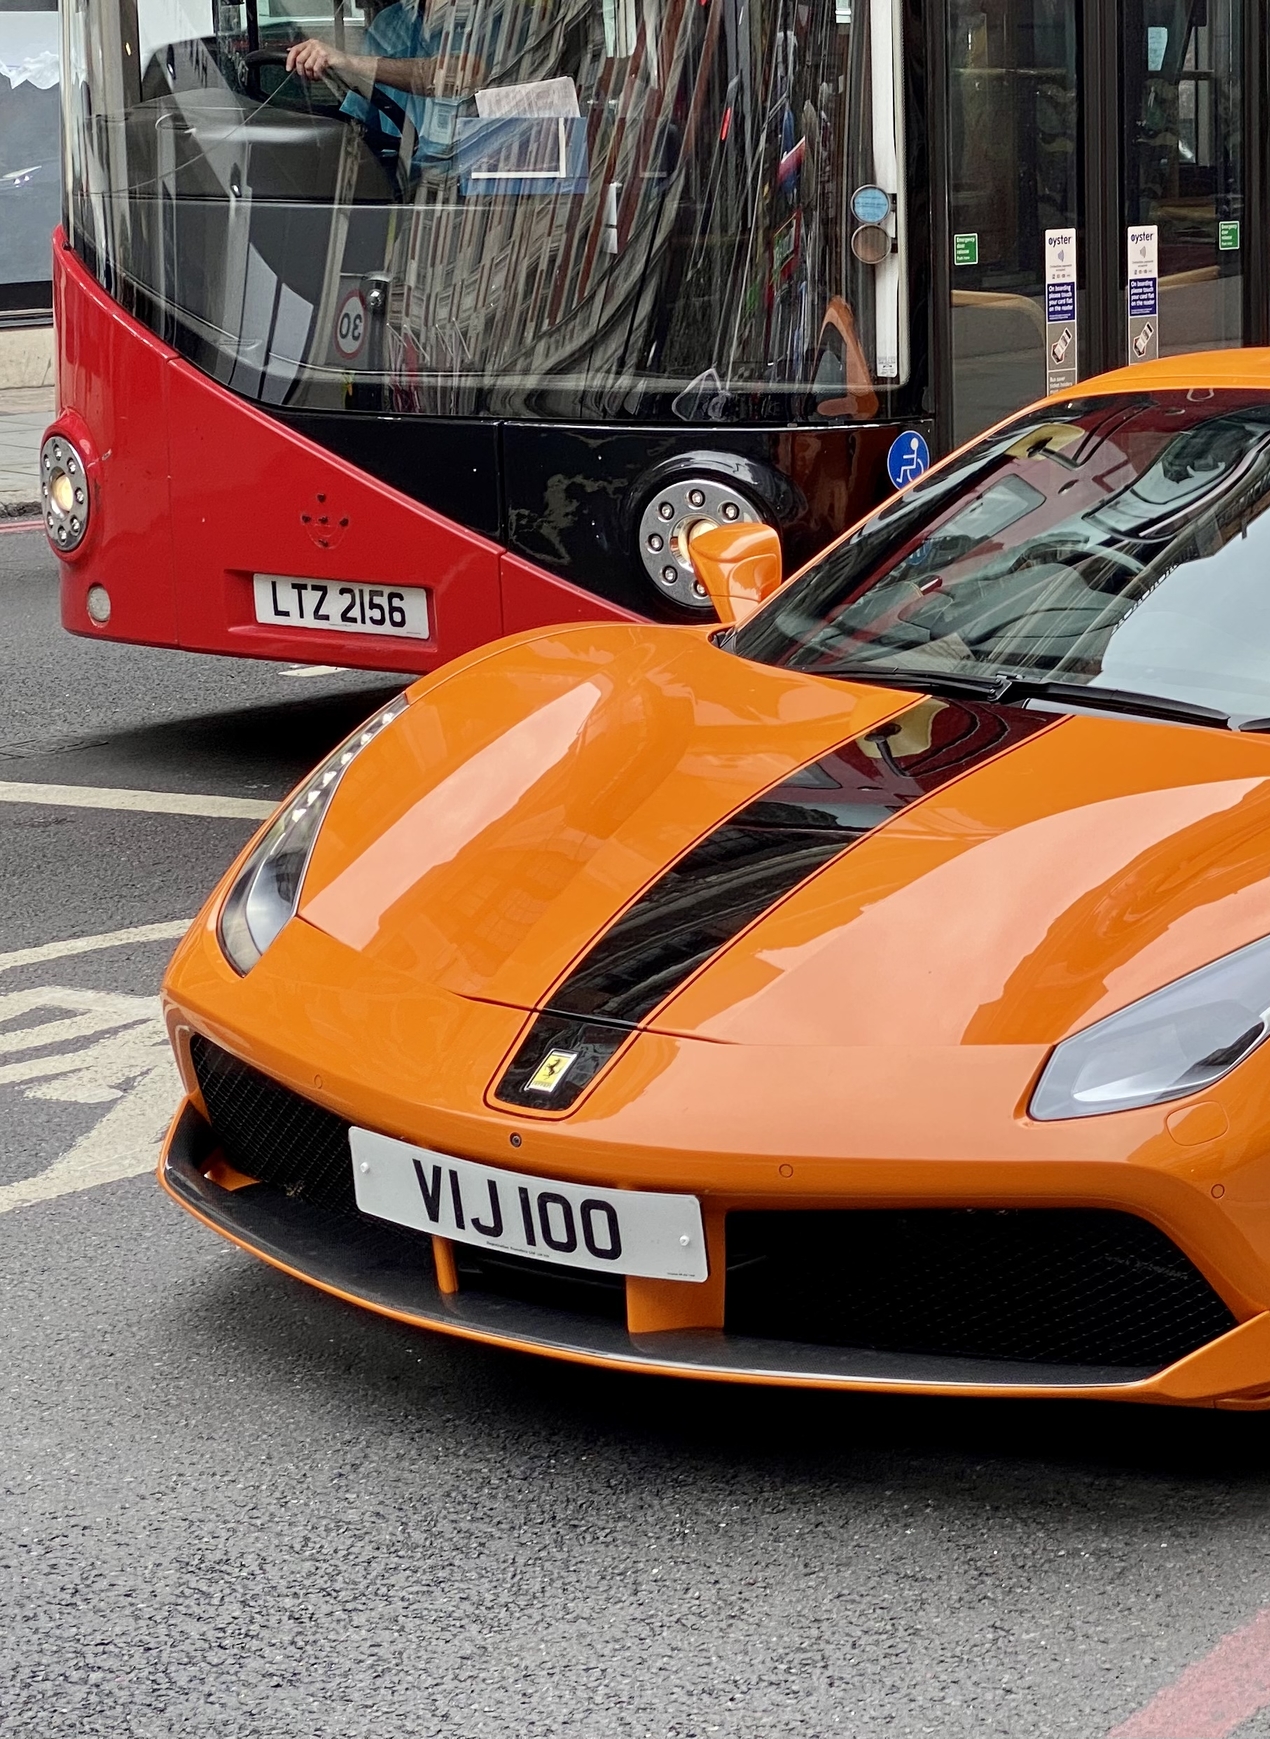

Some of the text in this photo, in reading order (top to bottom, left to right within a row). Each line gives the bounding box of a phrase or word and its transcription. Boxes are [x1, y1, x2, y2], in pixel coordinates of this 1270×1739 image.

[1048, 236, 1072, 248] oyster
[1130, 232, 1154, 244] oyster
[271, 580, 406, 628] LTZ 2156
